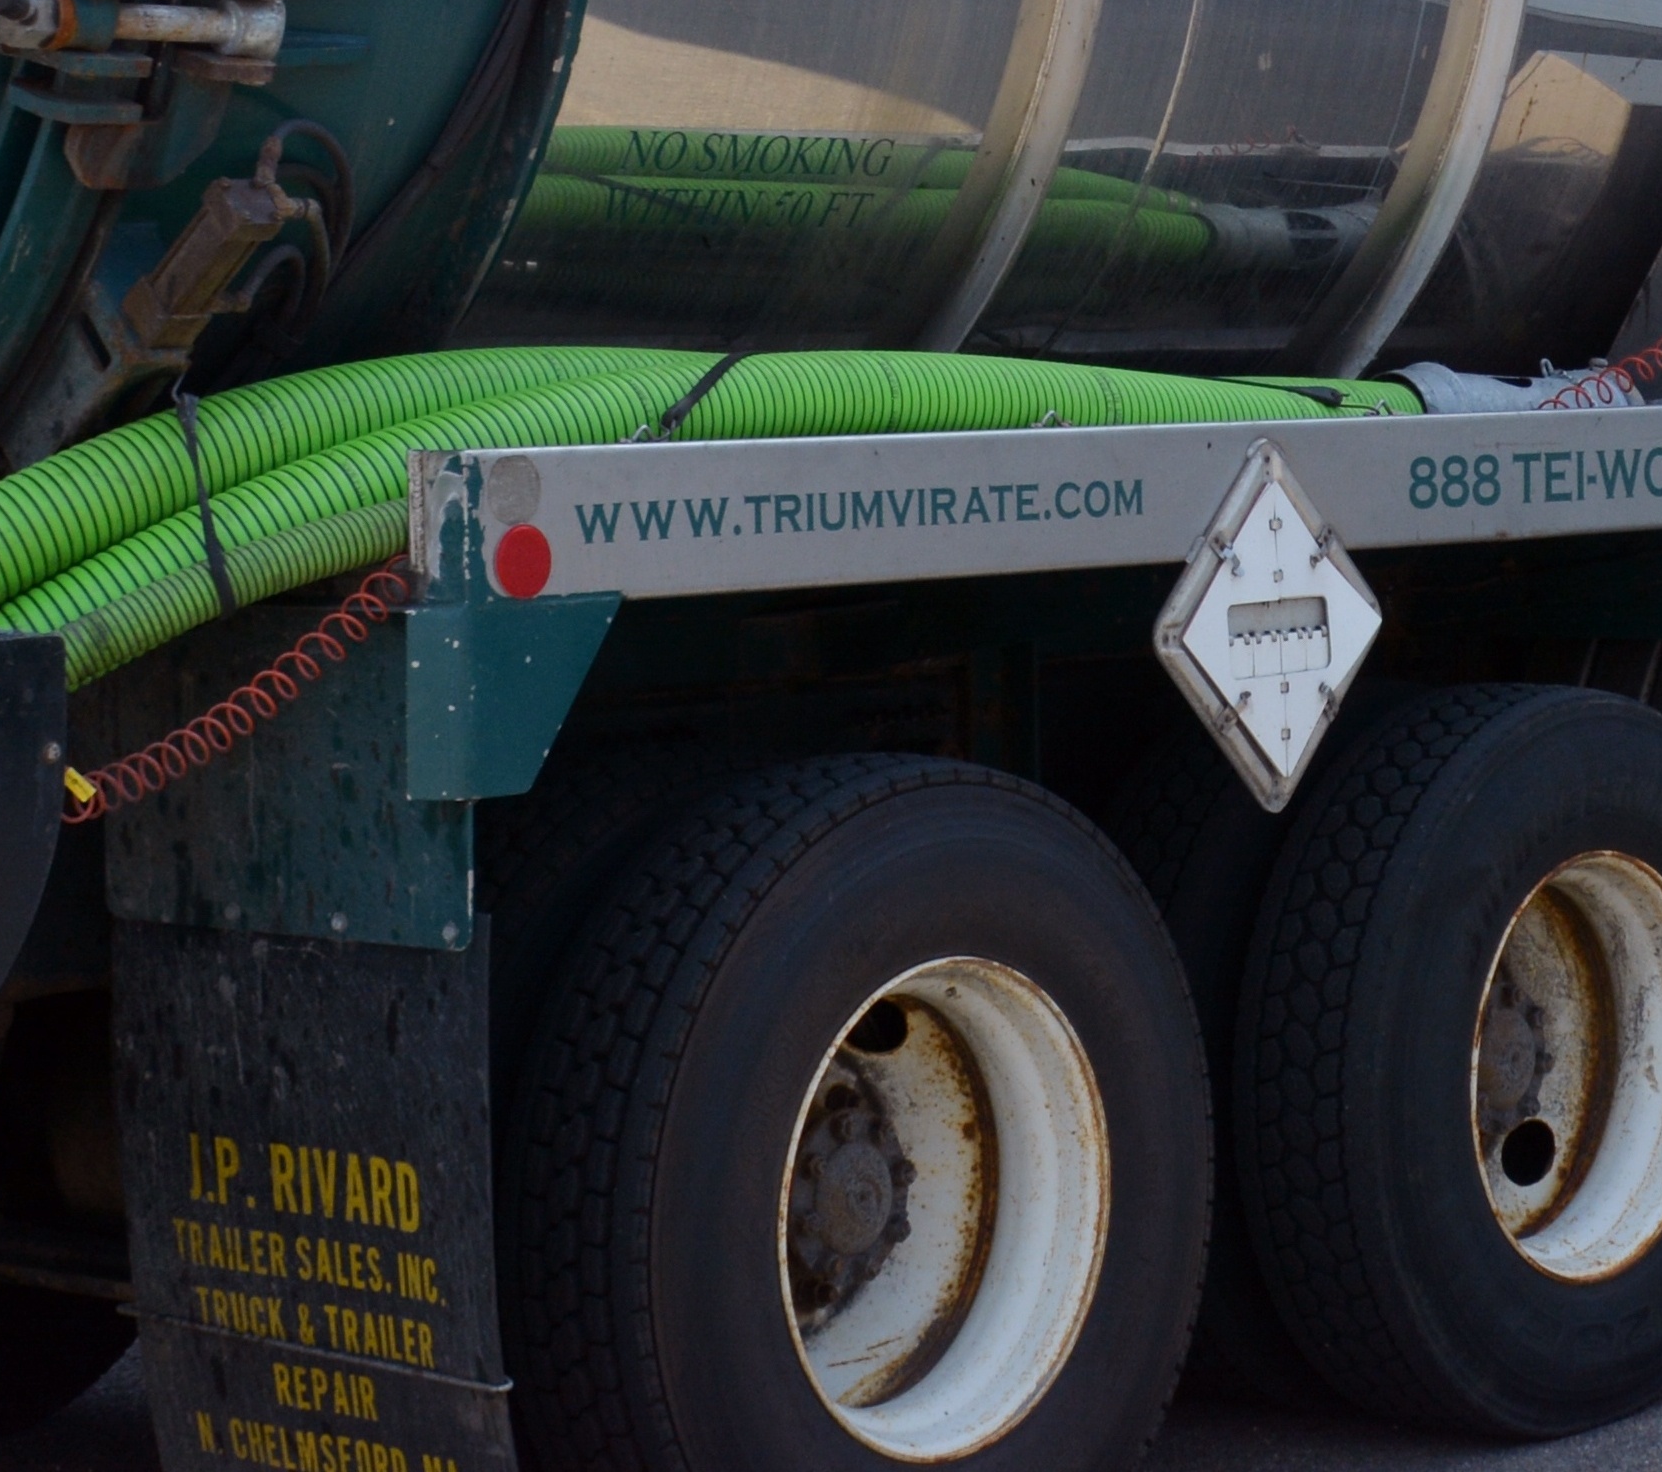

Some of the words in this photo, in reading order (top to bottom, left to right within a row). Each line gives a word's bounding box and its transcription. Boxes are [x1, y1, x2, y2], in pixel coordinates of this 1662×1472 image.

[620, 130, 687, 171] NO
[694, 133, 895, 177] SMOKING
[603, 187, 764, 226] WITHIN
[766, 190, 813, 227] 50
[818, 192, 875, 228] FT
[575, 477, 1144, 545] WWW.TRIUMVIRATE.COM
[1408, 453, 1501, 509] 888
[189, 1133, 256, 1209] J.P.
[270, 1143, 421, 1233] RIVARD
[173, 1218, 287, 1278] TRAILER
[398, 1252, 447, 1307] INC.
[195, 1286, 286, 1340] TRUCK
[298, 1303, 316, 1346] &
[324, 1305, 435, 1369] TRAILER
[273, 1362, 378, 1421] REPAIR
[196, 1410, 224, 1455] N.
[229, 1418, 408, 1471] CHELMSFORD
